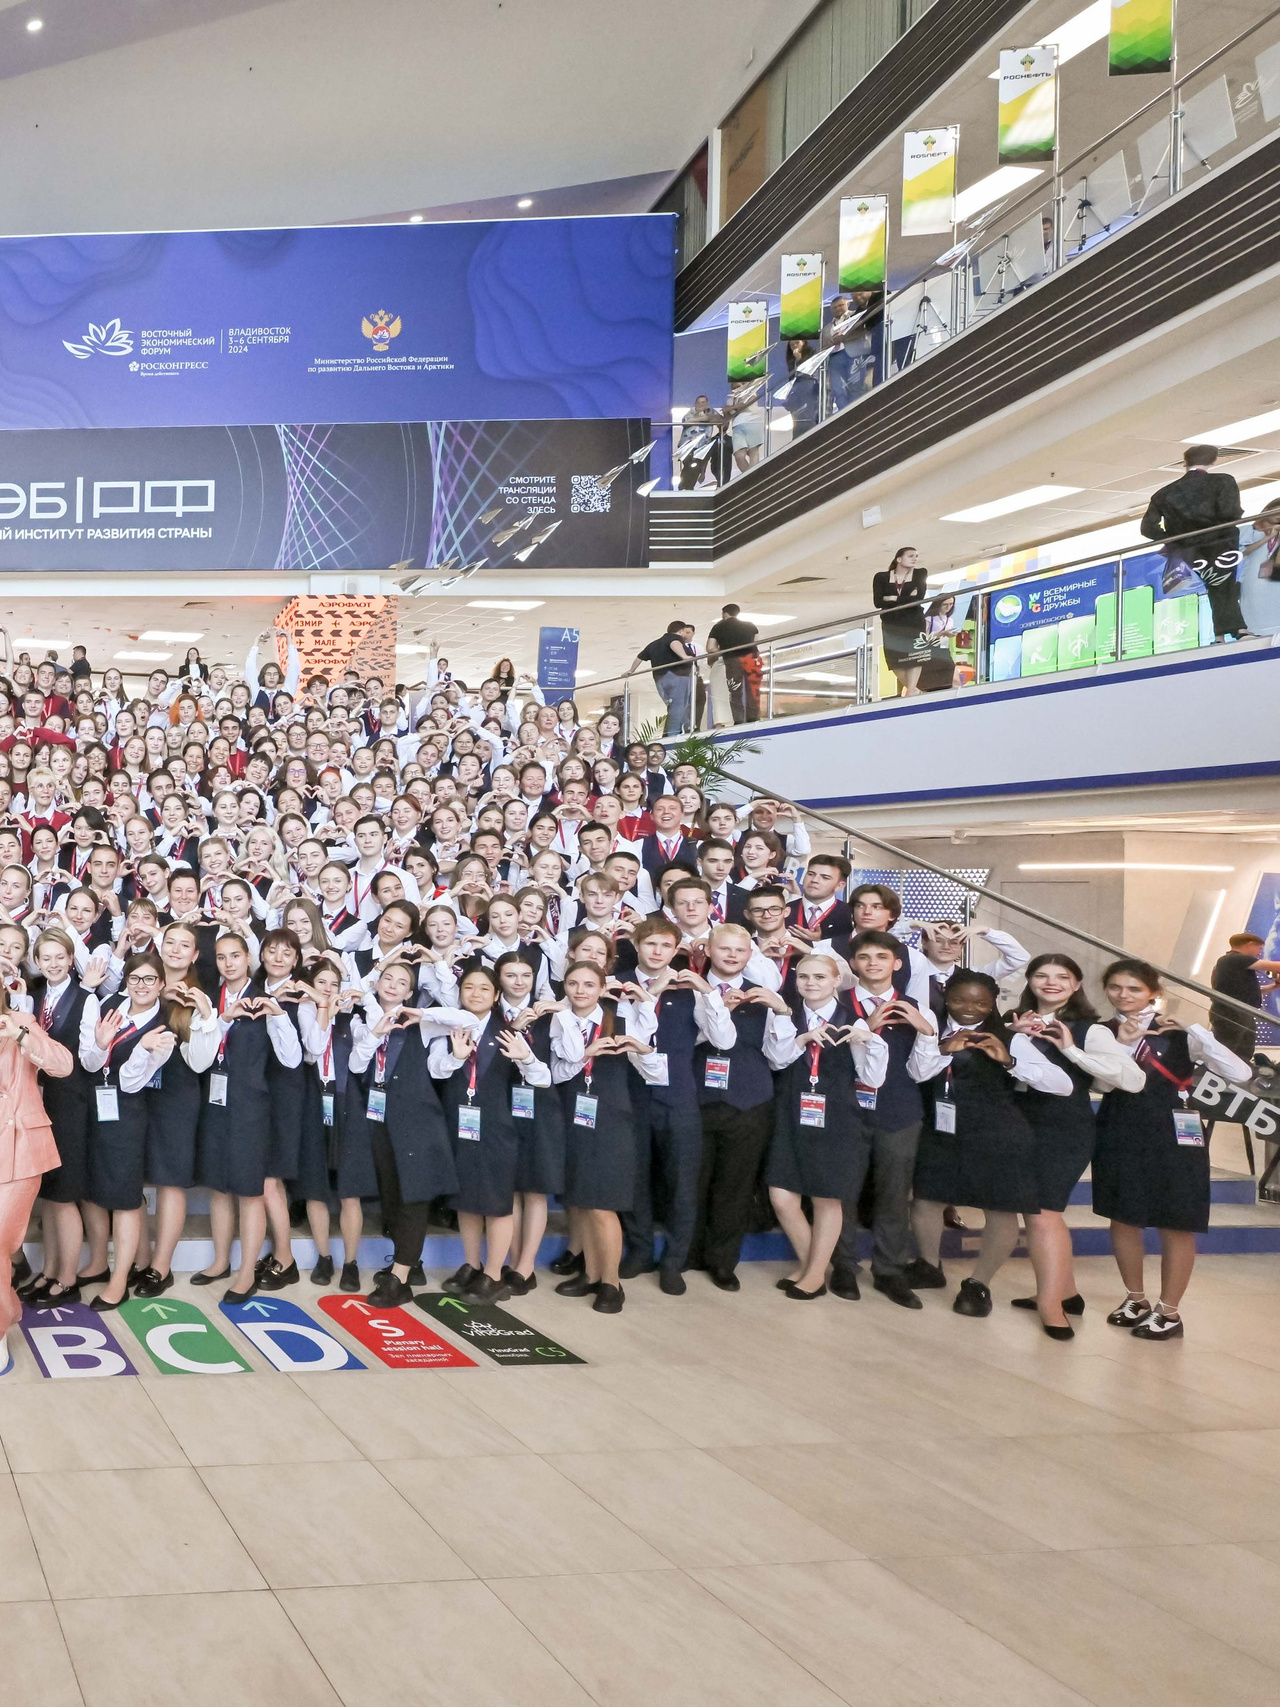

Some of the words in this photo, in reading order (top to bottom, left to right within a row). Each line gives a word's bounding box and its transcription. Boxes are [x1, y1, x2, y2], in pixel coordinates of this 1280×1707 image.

[1003, 72, 1051, 80] РОСНЕФТЬ
[142, 328, 192, 338] ВОСТОЧНЫЙ
[228, 327, 291, 337] ВЛАДИВОСТОК
[141, 337, 215, 346] ЭКОНОМИЧЕСКИЙ
[247, 336, 289, 344] СЕНТЯБРЯ
[140, 347, 170, 356] ФОРУМ
[228, 346, 248, 354] 2024
[140, 361, 208, 370] РОСКОНГРЕСС
[521, 496, 556, 504] СТЕНДА
[15, 528, 84, 540] ИНСТИТУТ
[87, 528, 155, 539] РАЗВИТИЯ
[158, 528, 212, 539] СТРАНЫ
[1043, 579, 1097, 597] ВСЕМИРНЫЕ
[1043, 593, 1066, 604] ИГРЫ
[1042, 598, 1080, 612] ДРУЖБЫ
[560, 628, 580, 642] A5
[1192, 1071, 1280, 1135] ВТБ
[368, 1319, 405, 1337] S
[28, 1326, 127, 1378] B
[145, 1323, 245, 1374] C
[236, 1322, 349, 1372] D
[534, 1346, 566, 1357] C5
